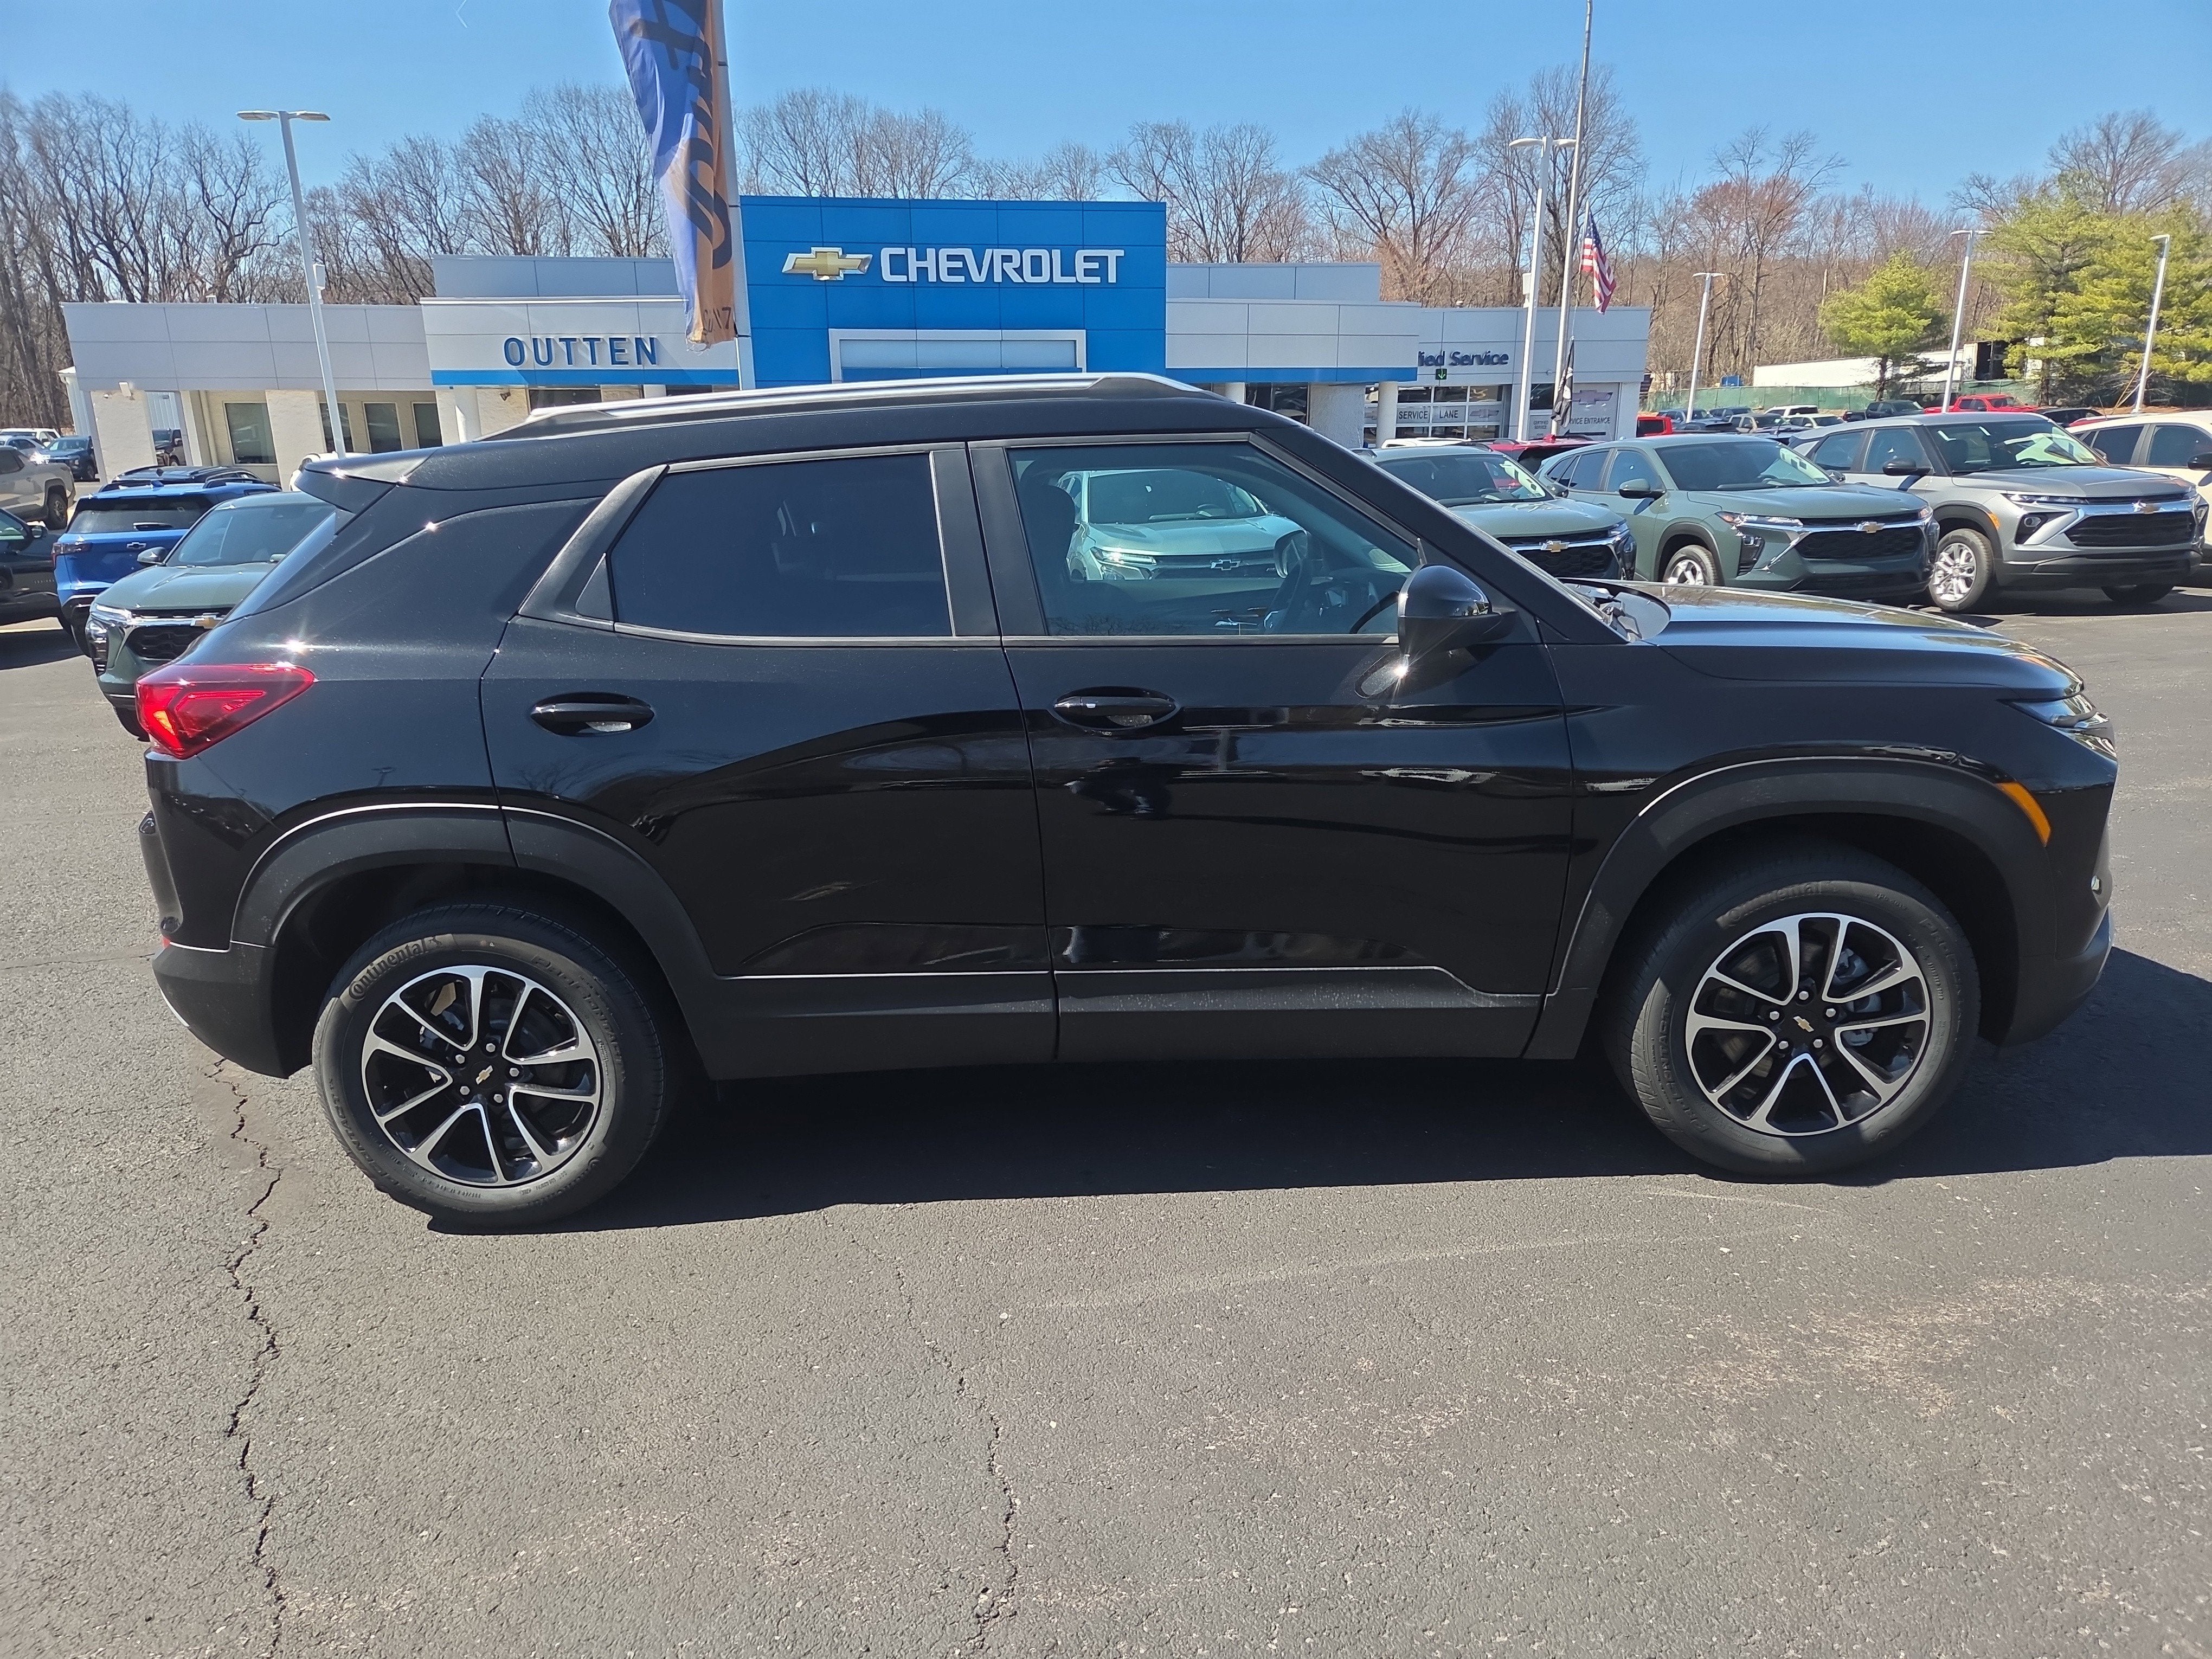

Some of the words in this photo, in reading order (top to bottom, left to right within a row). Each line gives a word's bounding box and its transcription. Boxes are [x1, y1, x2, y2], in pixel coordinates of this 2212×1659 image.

[880, 247, 1125, 284] CHEVROLET
[503, 337, 657, 366] OUTTEN
[1449, 350, 1509, 366] Service
[1398, 410, 1429, 420] SERVICE
[1439, 410, 1459, 419] LANE
[349, 939, 429, 1000] Continental
